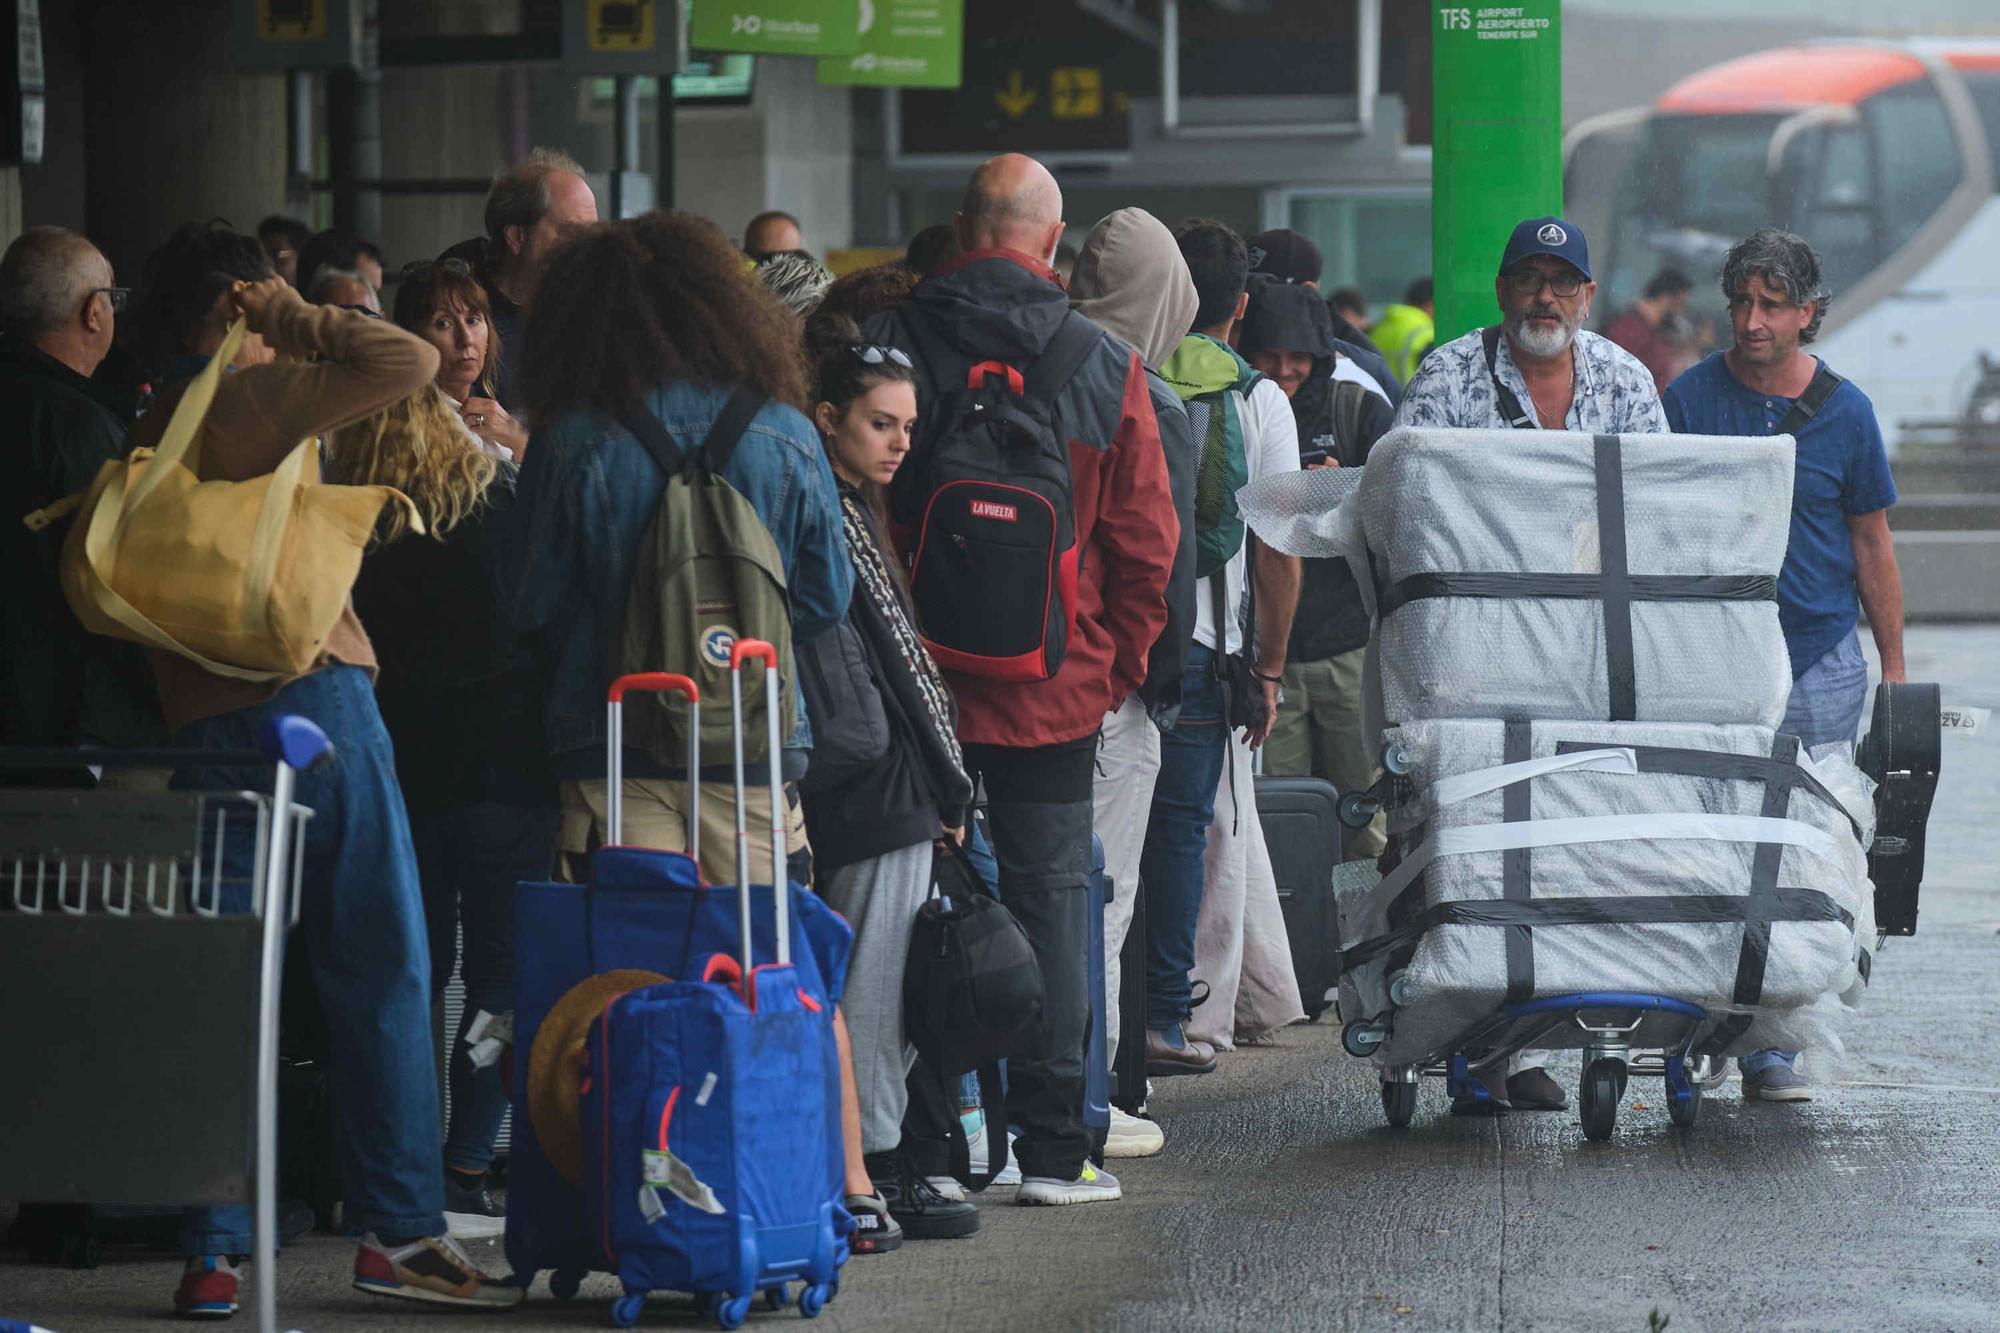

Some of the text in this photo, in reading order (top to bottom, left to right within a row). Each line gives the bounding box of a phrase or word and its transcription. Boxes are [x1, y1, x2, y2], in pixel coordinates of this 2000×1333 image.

[1476, 7, 1524, 17] AIRPORT
[1440, 8, 1471, 30] TFS
[1476, 18, 1550, 29] AEROPUERTO
[1477, 30, 1538, 39] TENERIFE SUR
[973, 502, 1014, 519] LA VUELTA
